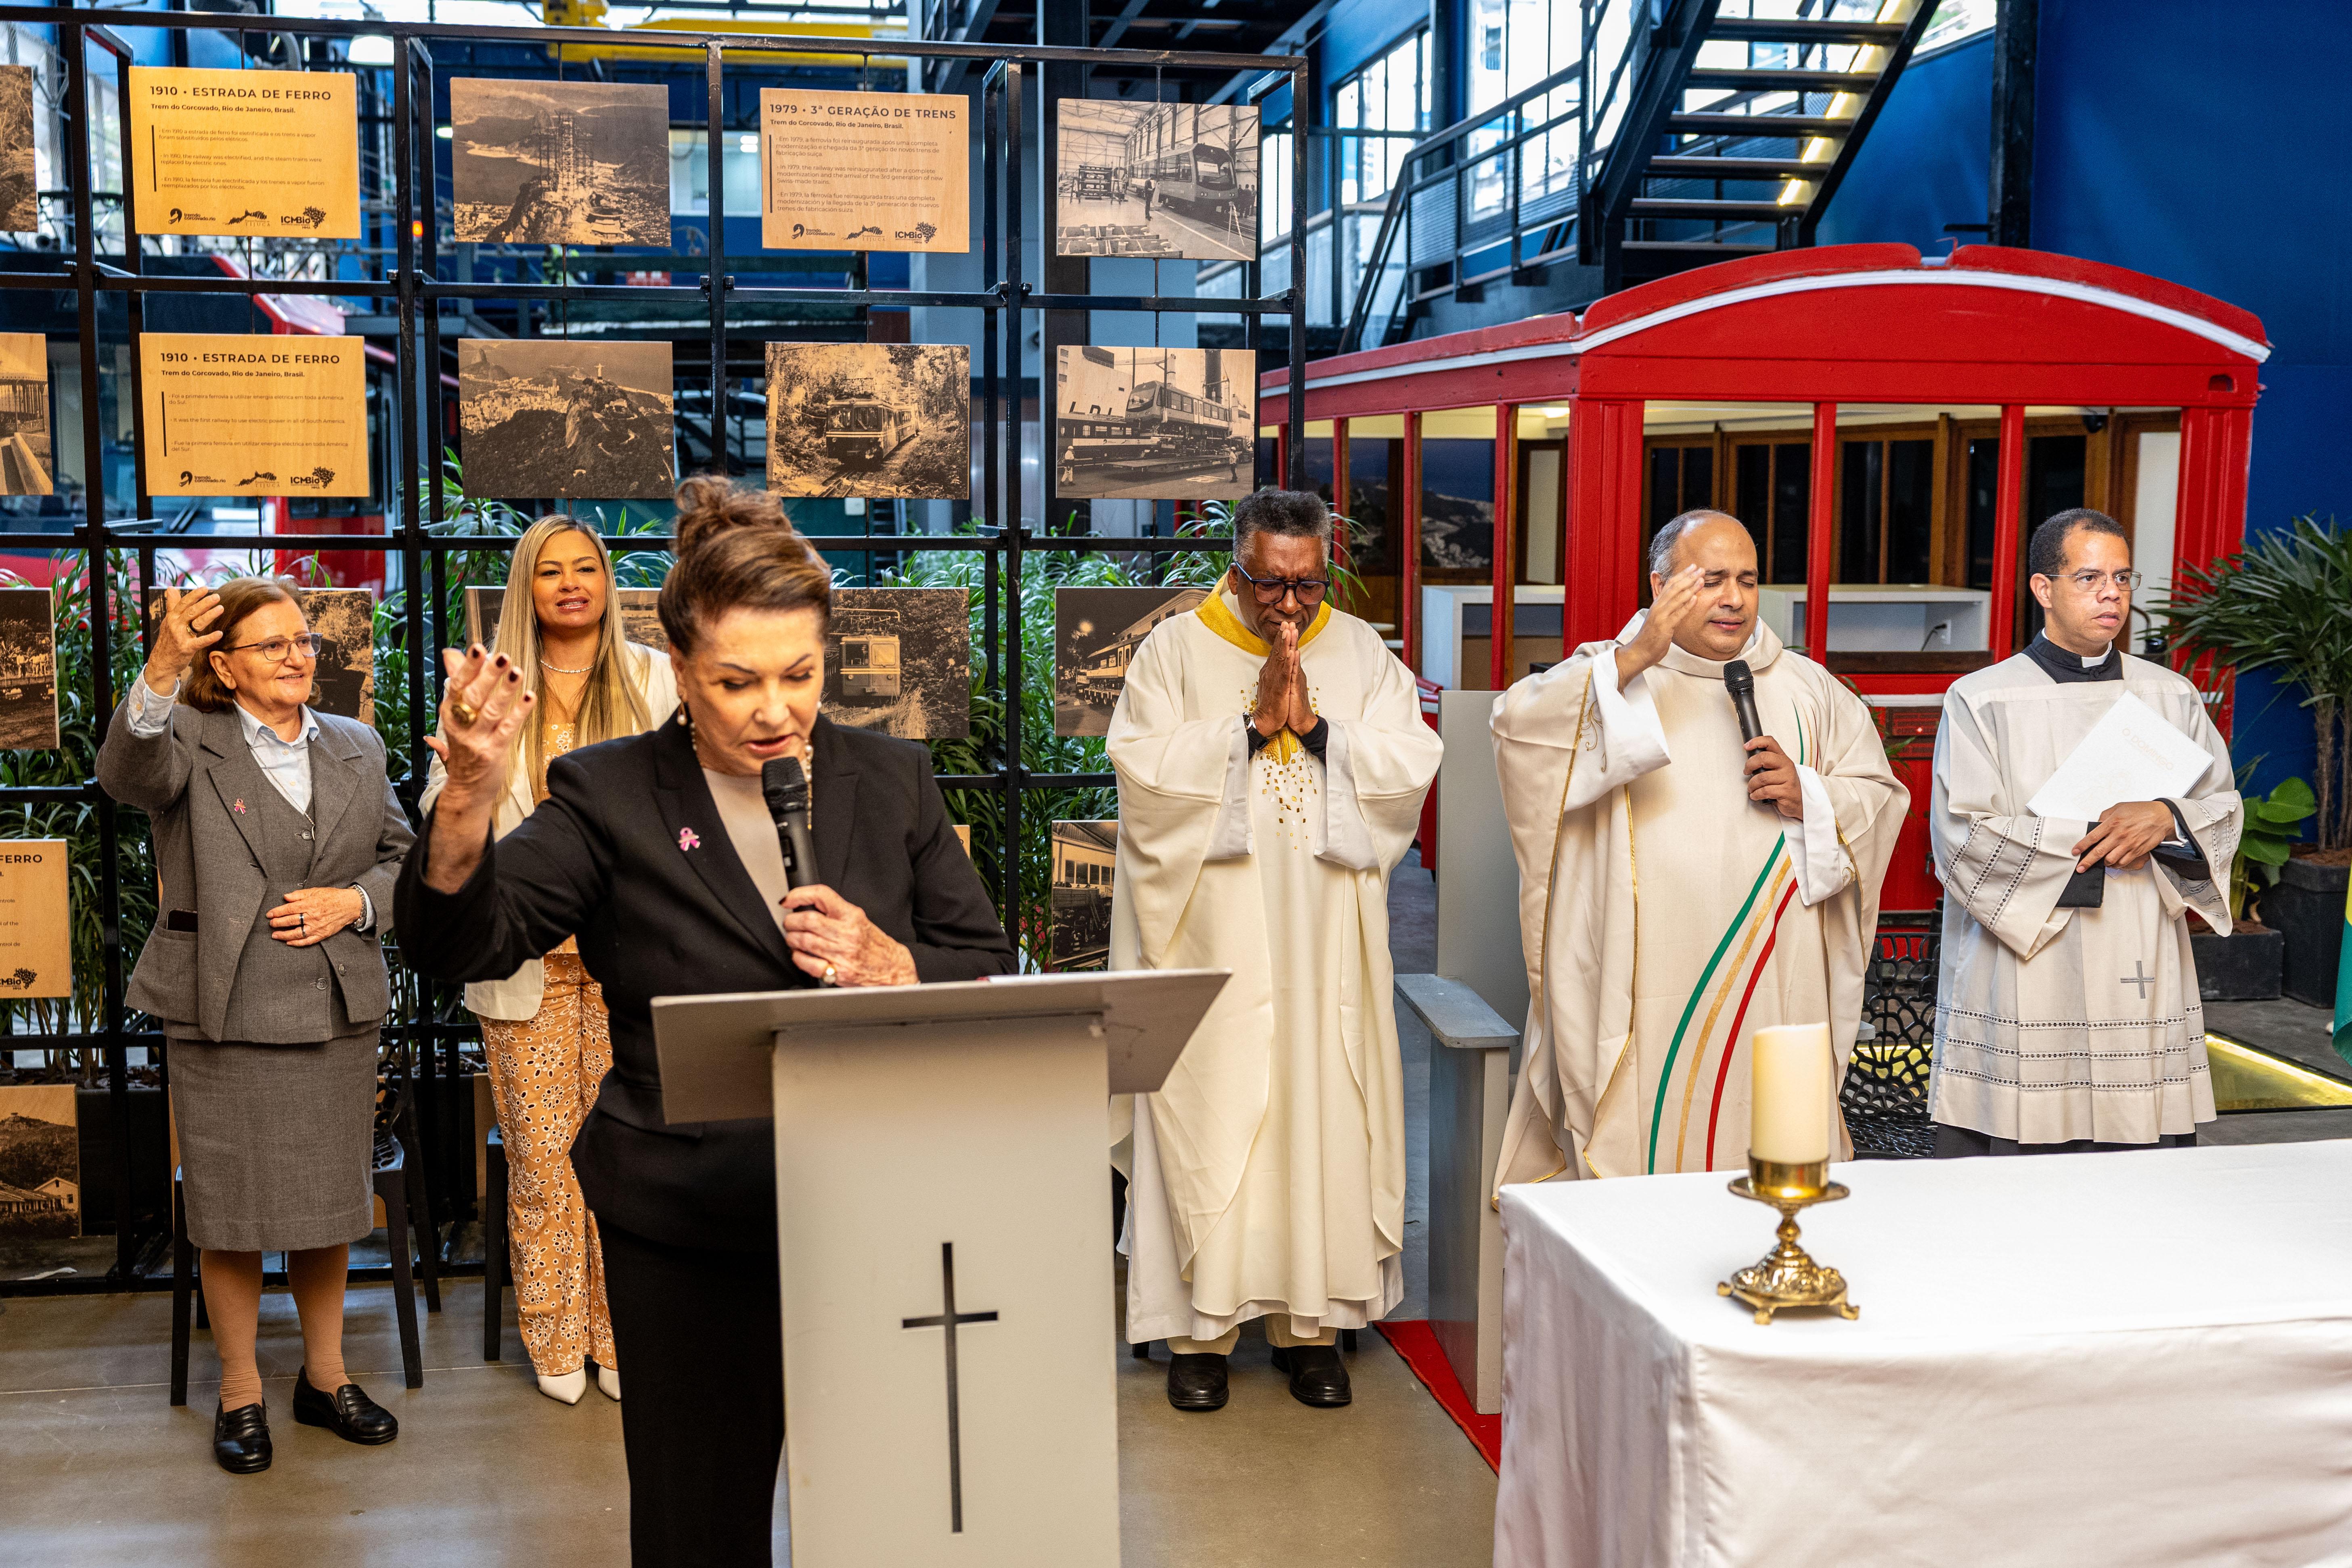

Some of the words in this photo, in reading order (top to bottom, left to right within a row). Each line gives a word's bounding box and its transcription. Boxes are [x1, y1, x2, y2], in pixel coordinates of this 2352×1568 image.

[150, 86, 178, 95] 1910
[193, 87, 256, 98] ESTRADA
[262, 89, 280, 98] DE
[286, 90, 331, 100] FERRO
[770, 104, 797, 113] 1979
[811, 105, 822, 114] 3ª
[827, 104, 889, 119] GERAÇÃO
[894, 108, 910, 117] DE
[915, 109, 955, 119] TRENS
[281, 216, 310, 224] ICMBio
[160, 353, 188, 362] 1910
[203, 353, 266, 363] ESTRADA
[272, 354, 289, 363] DE
[295, 354, 339, 364] FERRO
[2122, 728, 2130, 736] O
[2131, 736, 2173, 770] DOMINGO
